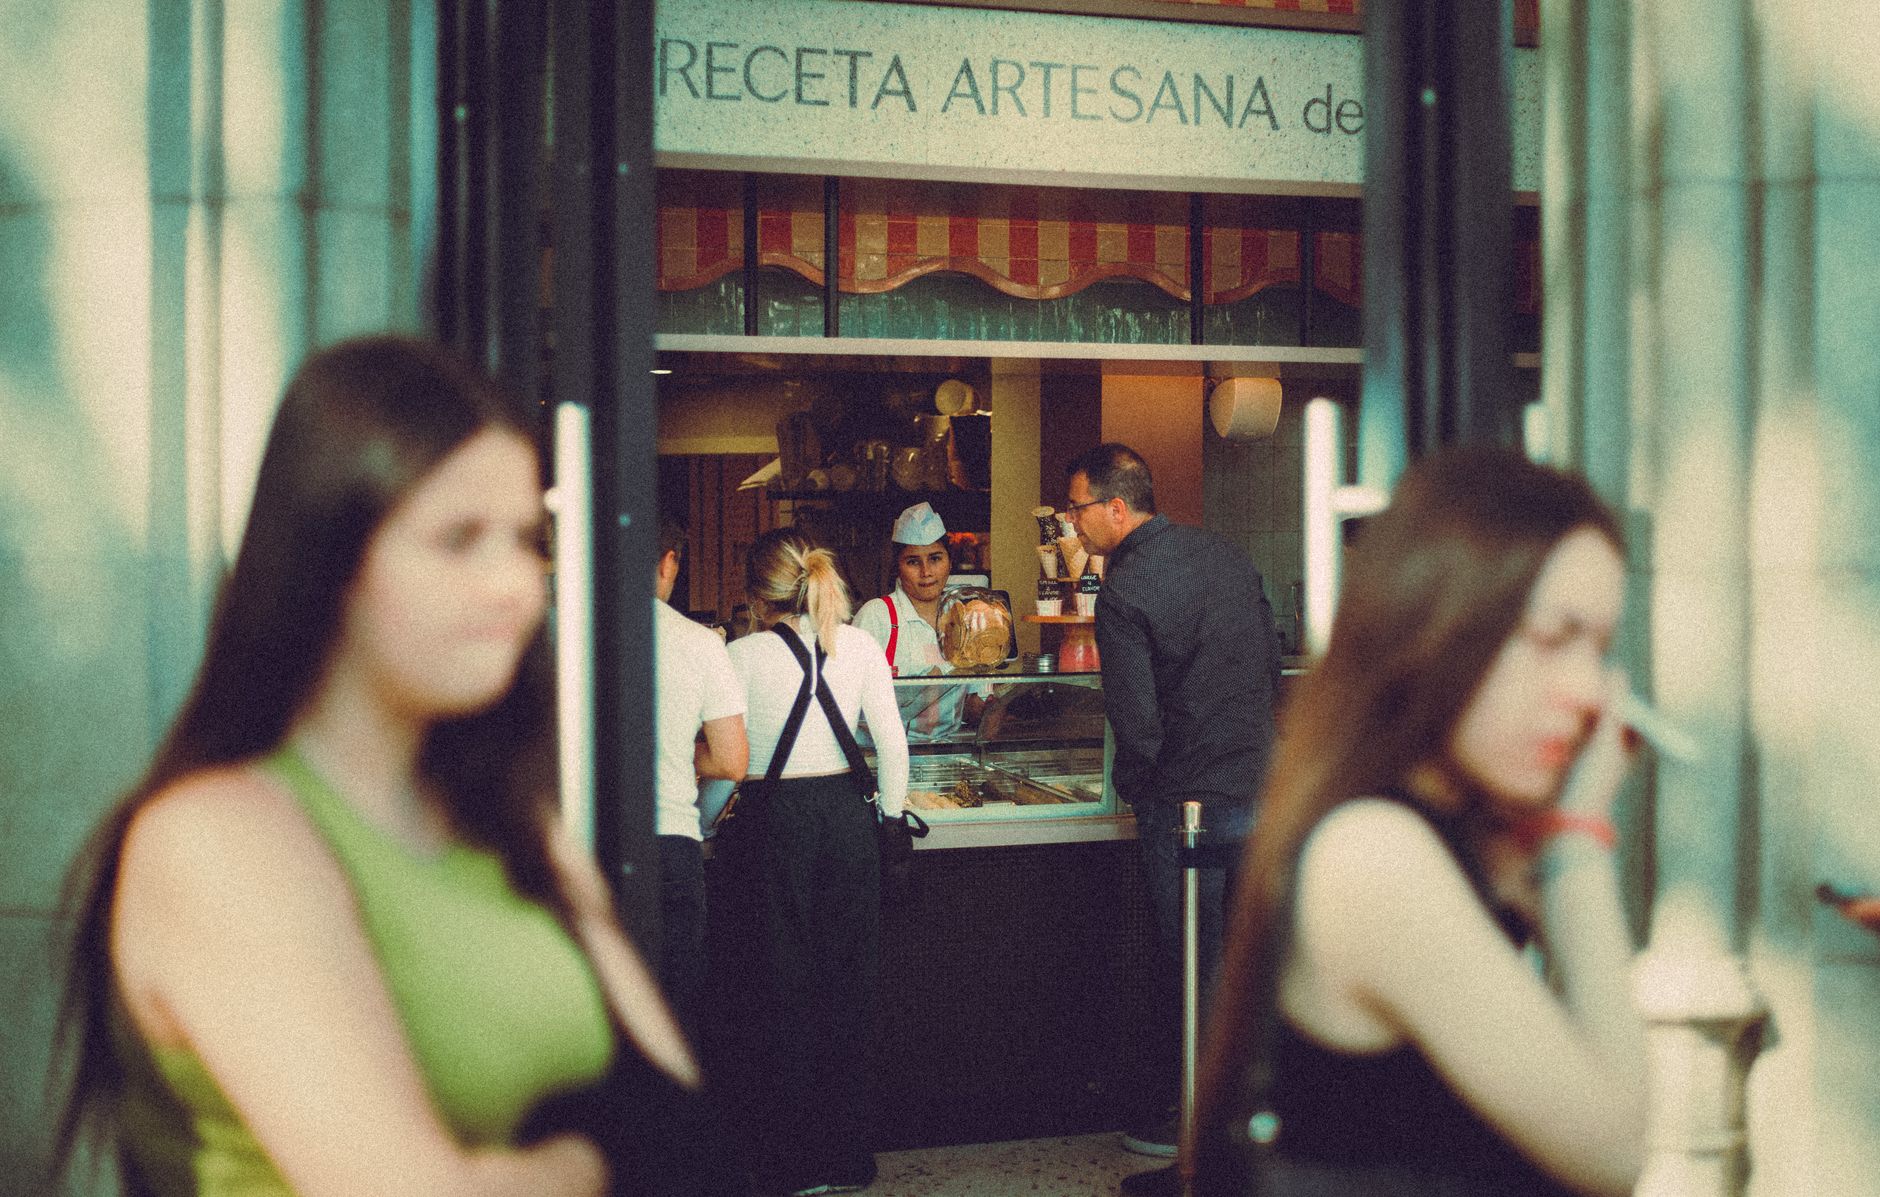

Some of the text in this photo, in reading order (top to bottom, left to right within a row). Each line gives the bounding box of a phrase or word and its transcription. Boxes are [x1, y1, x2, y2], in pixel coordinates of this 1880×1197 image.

[658, 38, 1364, 135] RECETA ARTESANA de
